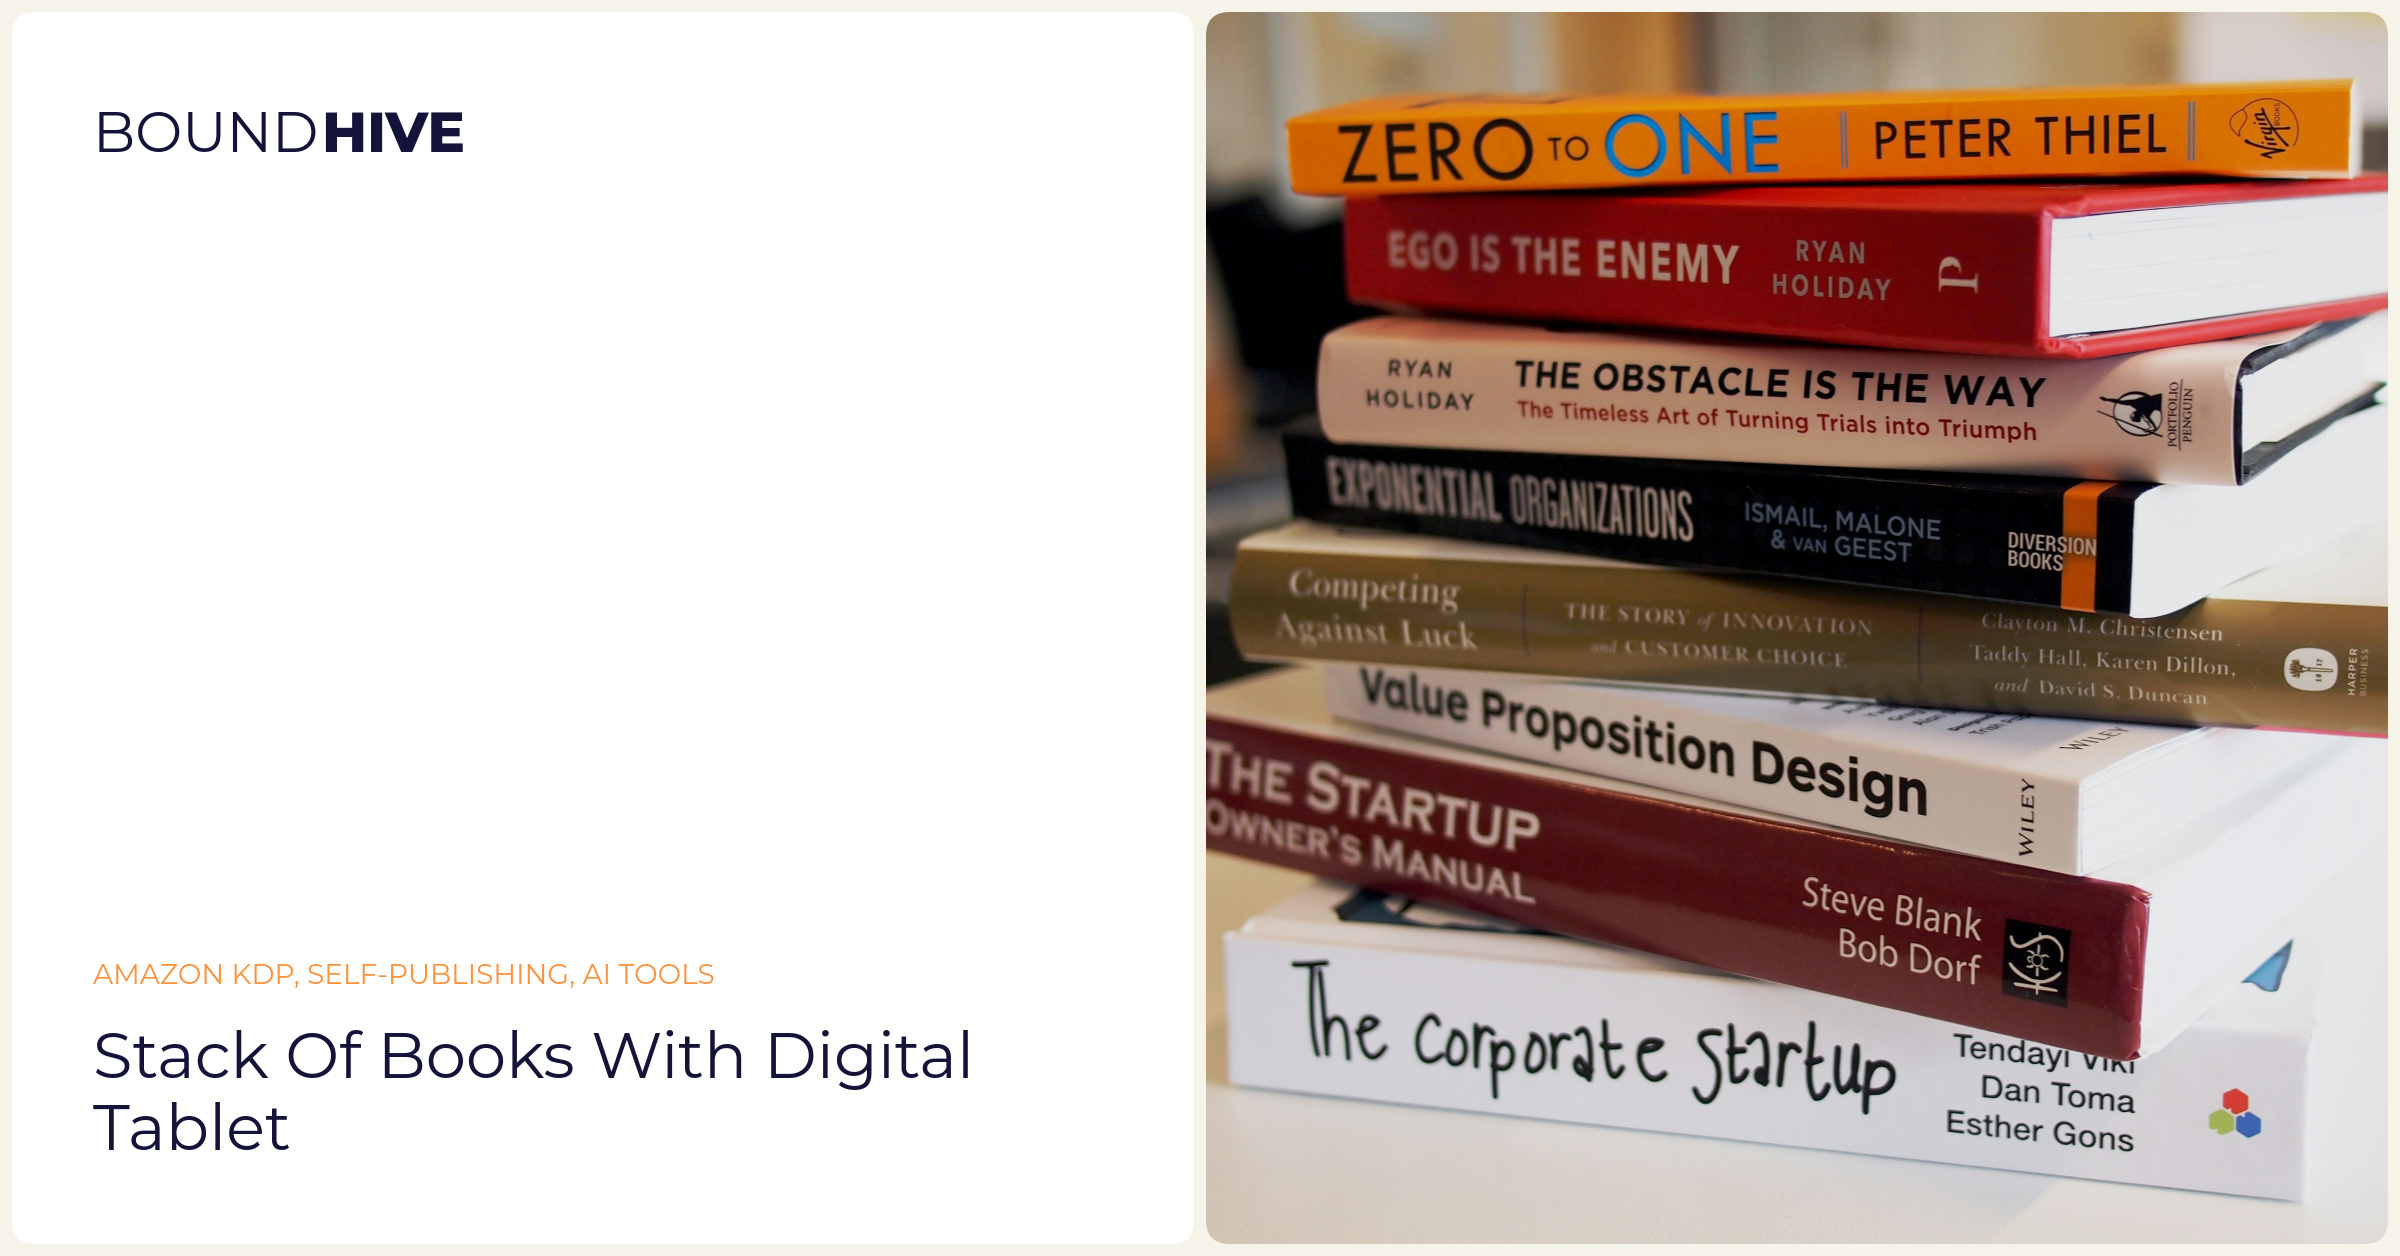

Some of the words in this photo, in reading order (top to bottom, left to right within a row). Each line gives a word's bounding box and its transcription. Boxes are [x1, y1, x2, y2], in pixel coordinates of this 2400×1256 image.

[2243, 107, 2292, 159] Virgin
[2273, 102, 2281, 126] BOOKS
[1338, 117, 1534, 183] ZERO
[1547, 137, 1590, 162] TO
[1604, 111, 1780, 178] ONE
[1874, 119, 2012, 160] PETER
[2034, 113, 2168, 157] THIEL
[1387, 230, 1459, 271] EGO
[1469, 234, 1501, 273] IS
[1511, 236, 1582, 278] THE
[1597, 239, 1740, 285] ENEMY
[1795, 239, 1867, 265] RYAN
[1771, 273, 1892, 301] HOLIDAY
[1387, 359, 1453, 380] RYAN
[1515, 360, 1582, 391] THE
[1594, 363, 1790, 399] OBSTACLE
[1802, 369, 1837, 401] IS
[1851, 371, 1929, 405] THE
[1943, 375, 2047, 410] WAY
[1366, 389, 1475, 412] HOLIDAY
[1516, 400, 1554, 421] The
[1560, 401, 1650, 426] Timeless
[1656, 405, 1690, 427] Art
[1696, 407, 1719, 428] of
[1725, 409, 1810, 435] Turning
[1816, 412, 1878, 436] Trials
[1884, 415, 1931, 438] into
[1937, 418, 2038, 443] Triumph
[2167, 381, 2179, 447] PORTFOLIO
[2182, 388, 2193, 443] PENGUIN
[1325, 456, 1503, 523] EXPONENTIAL
[1509, 473, 1695, 543] ORGANIZATIONS
[1743, 501, 1829, 534] ISMAIL,
[1834, 510, 1943, 542] MALONE
[1770, 529, 1787, 551] &
[1792, 536, 1828, 555] VAN
[1833, 534, 1914, 564] GEEST
[2007, 530, 2098, 558] DIVERSION
[2007, 548, 2065, 573] BOOKS
[1288, 567, 1461, 615] Competing
[1274, 610, 1389, 647] Against
[1401, 617, 1479, 652] Luck
[1564, 601, 1611, 622] THE
[1617, 604, 1691, 626] STORY
[1697, 611, 1719, 632] of
[1722, 611, 1874, 637] INNOVATION
[1980, 611, 2058, 637] Clayton
[2066, 617, 2091, 634] M.
[2099, 617, 2224, 642] Christensen
[1623, 639, 1750, 664] CUSTOMER
[1756, 647, 1848, 669] CHOICE
[1968, 643, 2031, 668] Taddy
[2038, 647, 2088, 669] Hall,
[2096, 651, 2158, 672] Karen
[2165, 655, 2237, 678] Dillon,
[2347, 647, 2358, 696] HARPER
[2359, 648, 2369, 697] BUSINESS
[1993, 677, 2029, 693] and
[2039, 679, 2096, 698] David
[2102, 684, 2121, 699] S.
[2128, 685, 2208, 705] Duncan
[1360, 667, 1469, 722] Value
[1481, 688, 1736, 778] Proposition
[1751, 740, 1929, 819] Design
[2058, 725, 2129, 752] WILEY
[1206, 737, 1294, 806] THE
[1306, 759, 1541, 853] STARTUP
[2017, 777, 2036, 857] WILEY
[1370, 834, 1537, 905] MANUAL
[1801, 875, 1886, 922] Steve
[1895, 893, 1983, 943] Blank
[1837, 928, 1899, 970] Bob
[1909, 942, 1982, 985] Dorf
[1291, 960, 1389, 1063] The
[1981, 1074, 2040, 1104] Dan
[2050, 1080, 2136, 1114] Toma
[1946, 1108, 2043, 1142] Esther
[2053, 1120, 2135, 1152] Gons
